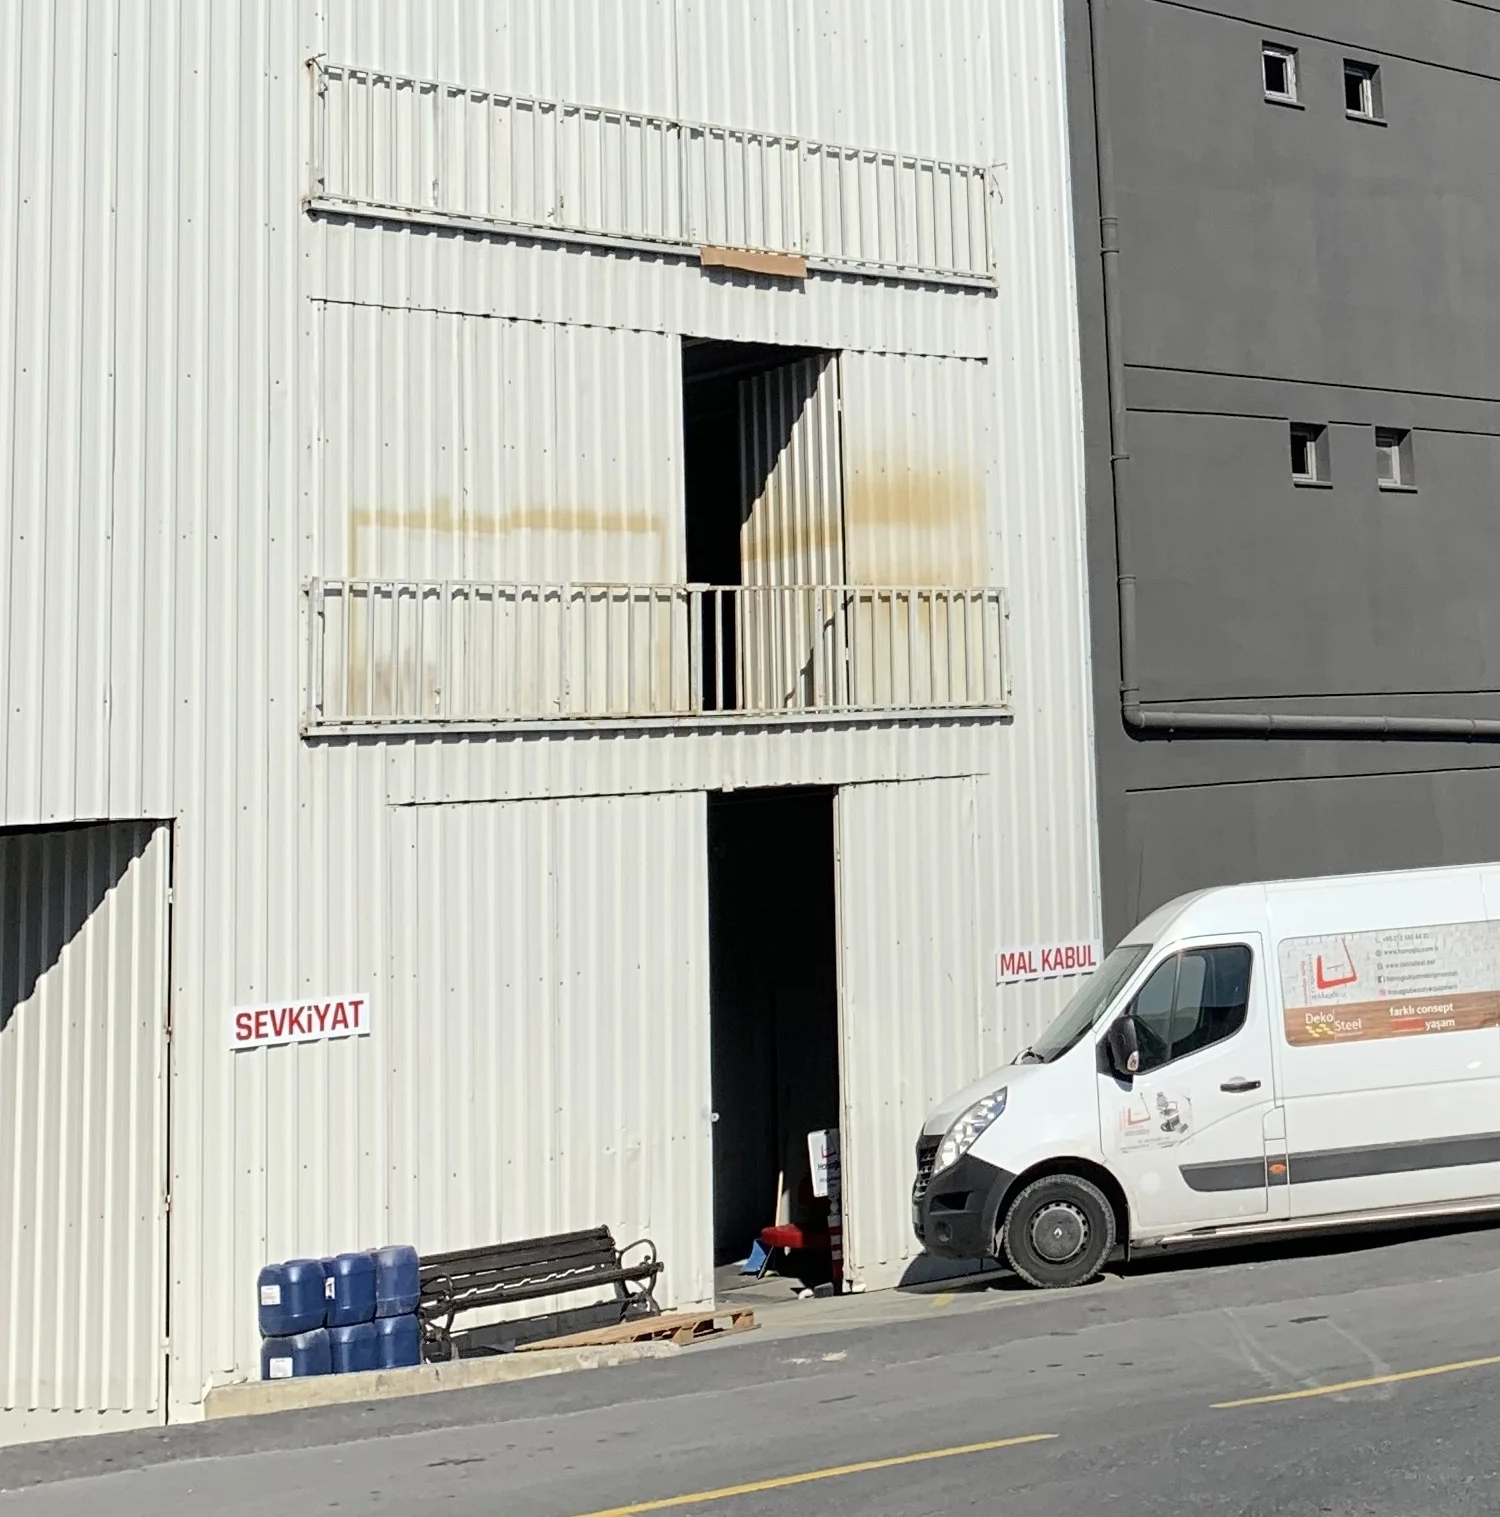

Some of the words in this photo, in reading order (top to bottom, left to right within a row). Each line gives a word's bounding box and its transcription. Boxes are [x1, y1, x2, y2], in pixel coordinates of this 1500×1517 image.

[1000, 951, 1037, 976] MAL
[1041, 944, 1097, 972] KABUL
[1416, 1003, 1454, 1015] consept
[1305, 1012, 1333, 1025] Deko
[1335, 1017, 1362, 1032] Steel
[1425, 1018, 1456, 1032] yaşam
